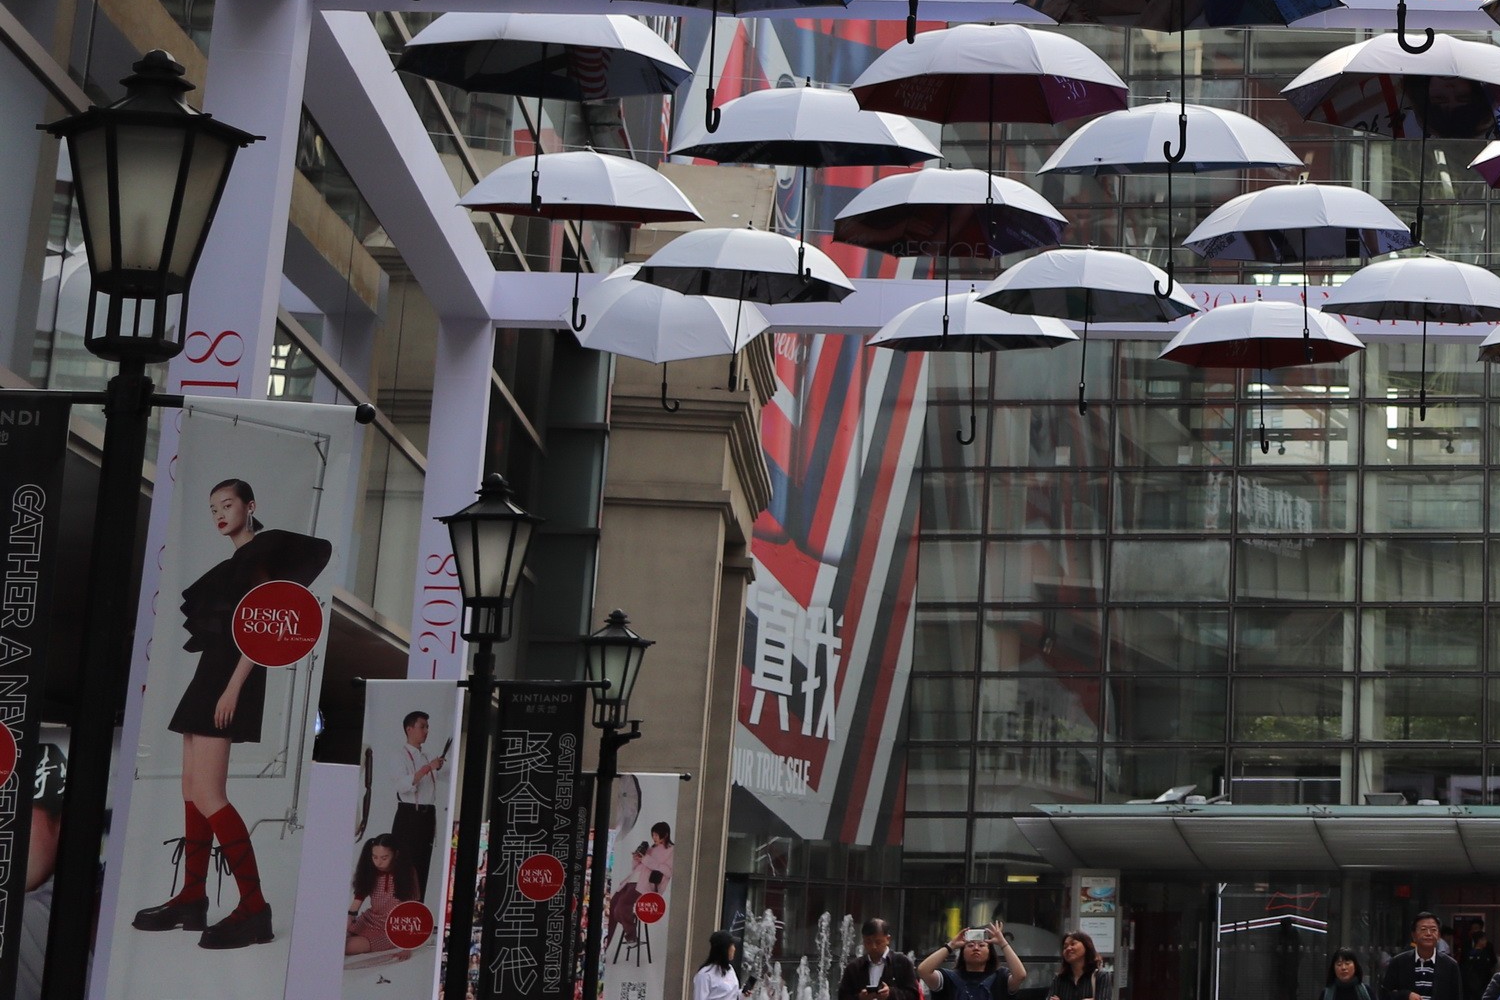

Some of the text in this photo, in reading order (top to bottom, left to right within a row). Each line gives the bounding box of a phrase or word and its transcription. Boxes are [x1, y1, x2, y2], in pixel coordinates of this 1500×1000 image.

[1062, 81, 1086, 101] 30
[3, 483, 47, 629] GATHER
[241, 607, 300, 622] DESIGN
[243, 617, 302, 641] SOCIAL
[0, 643, 32, 672] A
[749, 589, 844, 741] 真我
[512, 693, 573, 703] XINTIANDI
[555, 732, 576, 810] GATHER
[757, 752, 786, 793] TRUE
[785, 756, 811, 796] SELF
[553, 813, 571, 829] A
[521, 869, 552, 878] DESIGN
[522, 874, 554, 887] SOCIAL
[389, 914, 422, 925] DESIGN
[391, 923, 424, 938] SOCIAL
